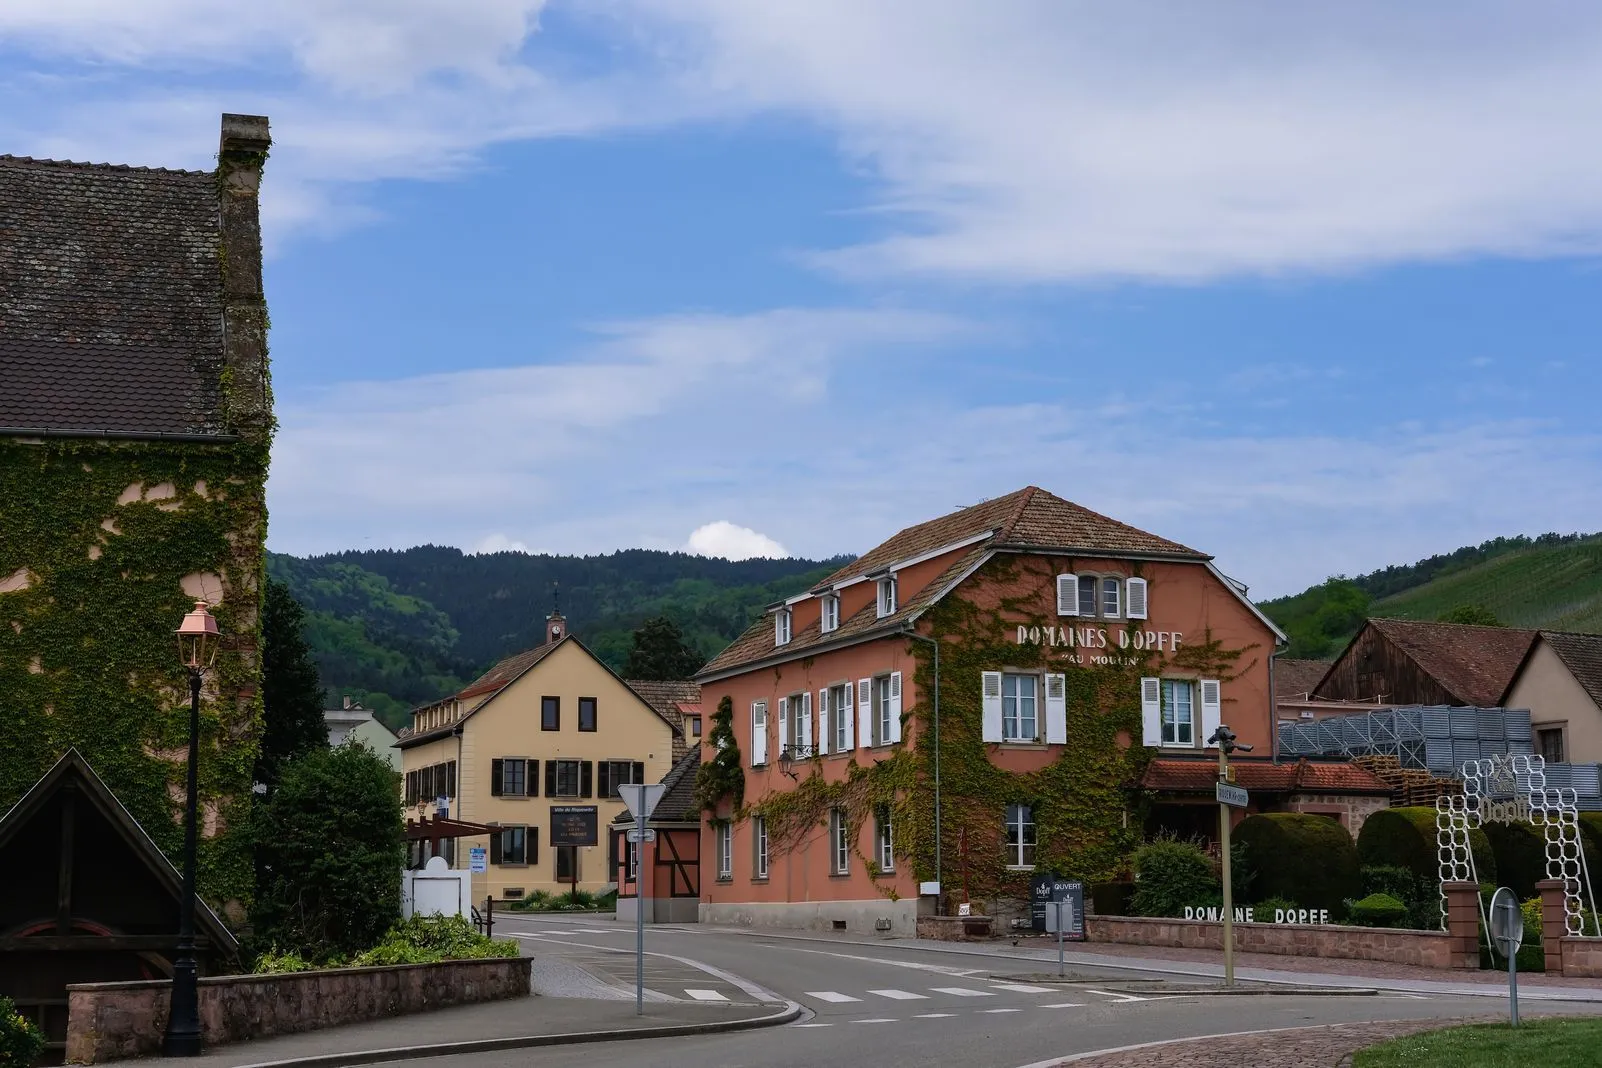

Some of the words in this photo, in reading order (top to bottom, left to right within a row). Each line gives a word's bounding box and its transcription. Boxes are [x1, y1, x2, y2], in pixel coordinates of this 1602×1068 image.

[1017, 625, 1107, 649] DOMAINES
[1119, 629, 1183, 651] DOPFF
[1275, 908, 1328, 924] DOPFF
